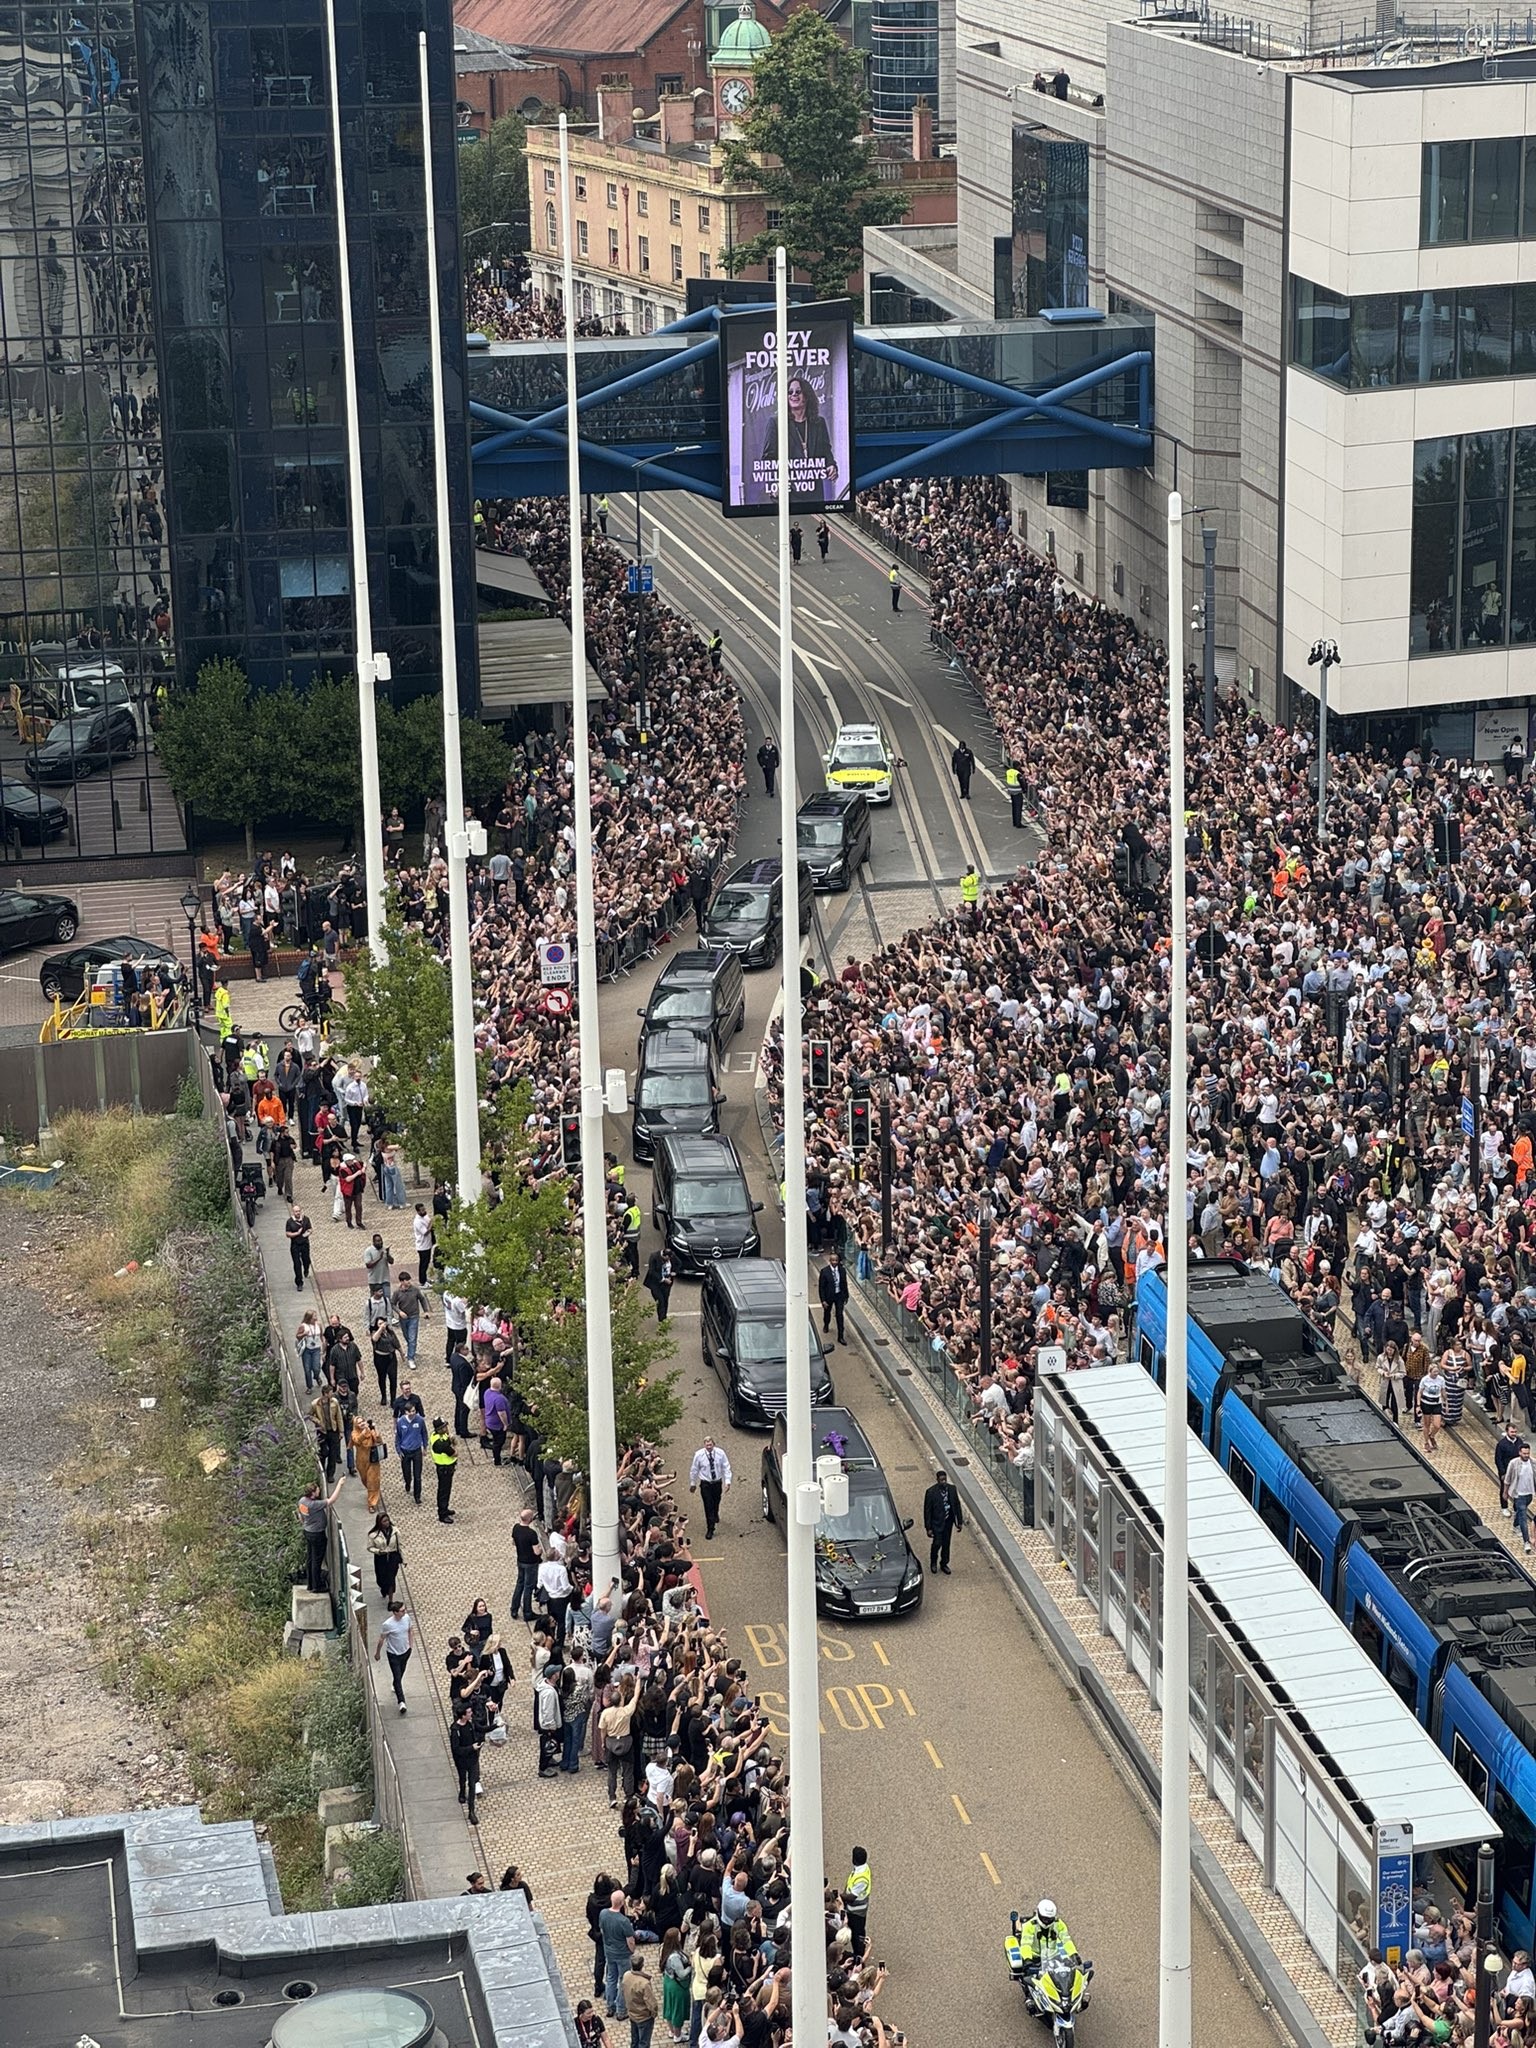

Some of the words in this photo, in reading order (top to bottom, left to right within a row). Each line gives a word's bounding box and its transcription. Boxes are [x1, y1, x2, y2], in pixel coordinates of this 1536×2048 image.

[763, 330, 812, 349] OZY
[753, 458, 826, 470] BIRMNGHAM
[765, 482, 792, 493] LOE
[794, 481, 815, 492] YOU
[755, 1683, 895, 1737] SOP
